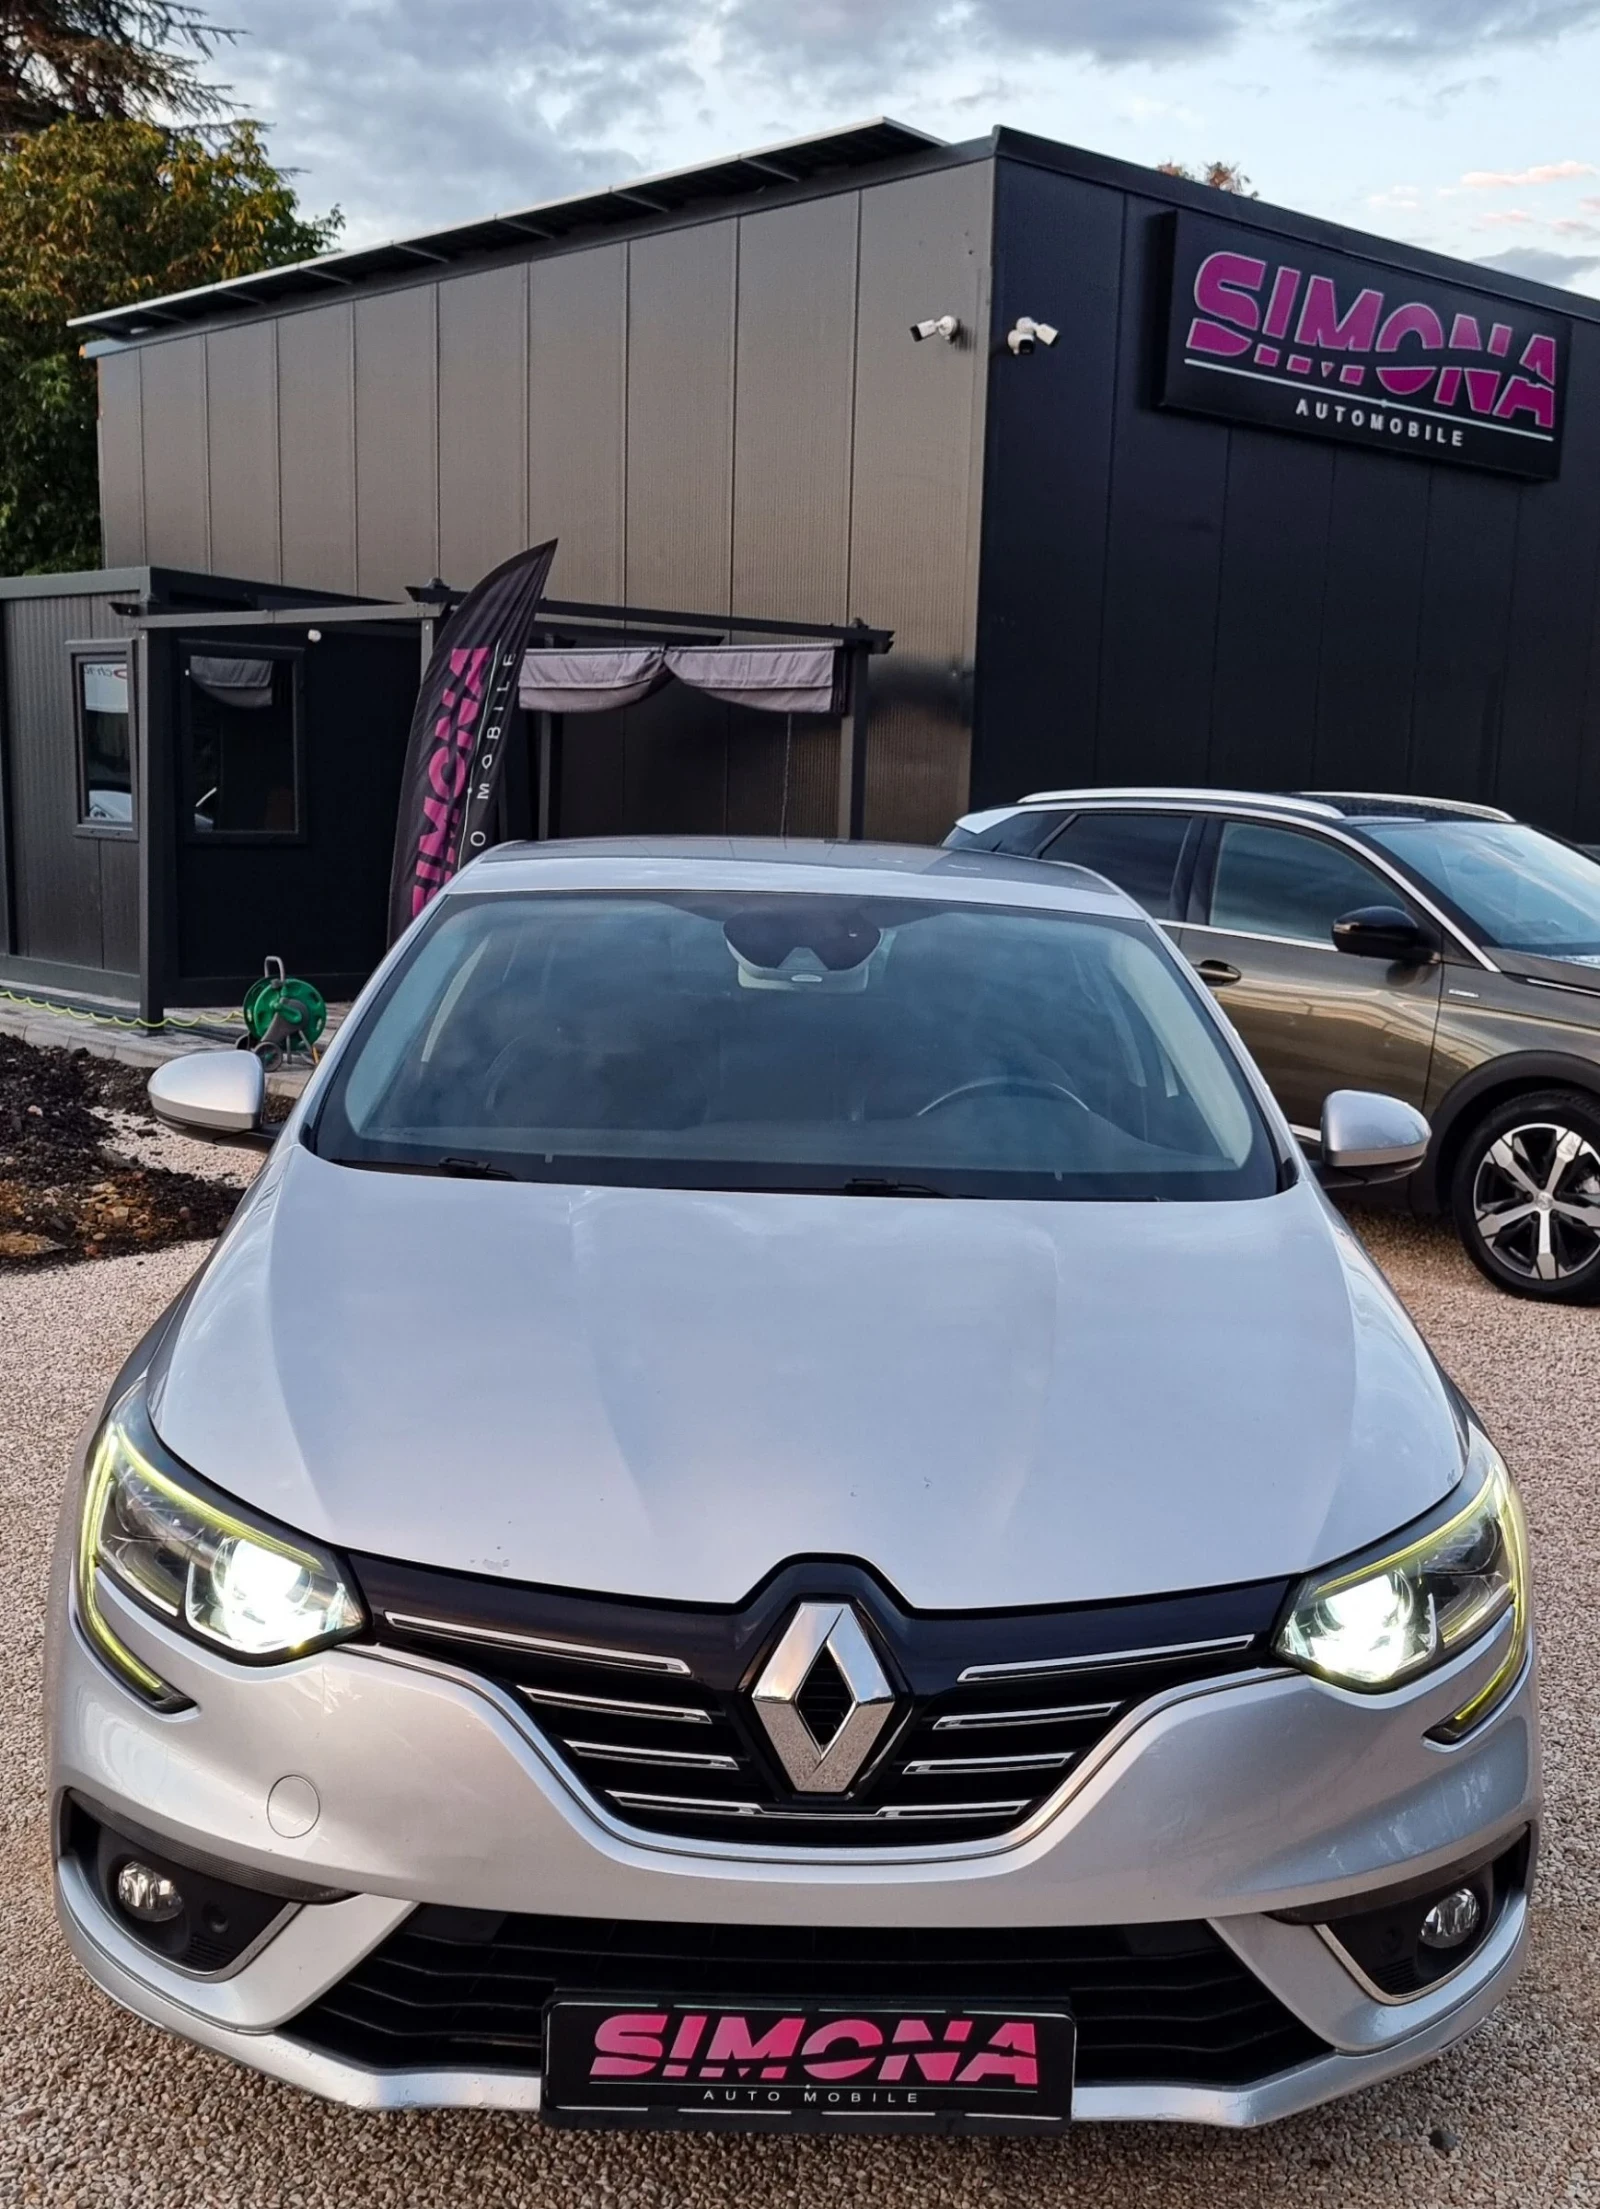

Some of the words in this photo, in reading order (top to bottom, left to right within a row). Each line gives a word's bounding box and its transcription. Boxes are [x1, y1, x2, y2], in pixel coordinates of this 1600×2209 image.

[1186, 250, 1556, 429] SIMONA
[1296, 399, 1464, 447] AUTOMOBILE
[589, 2013, 1039, 2085] SIMONA
